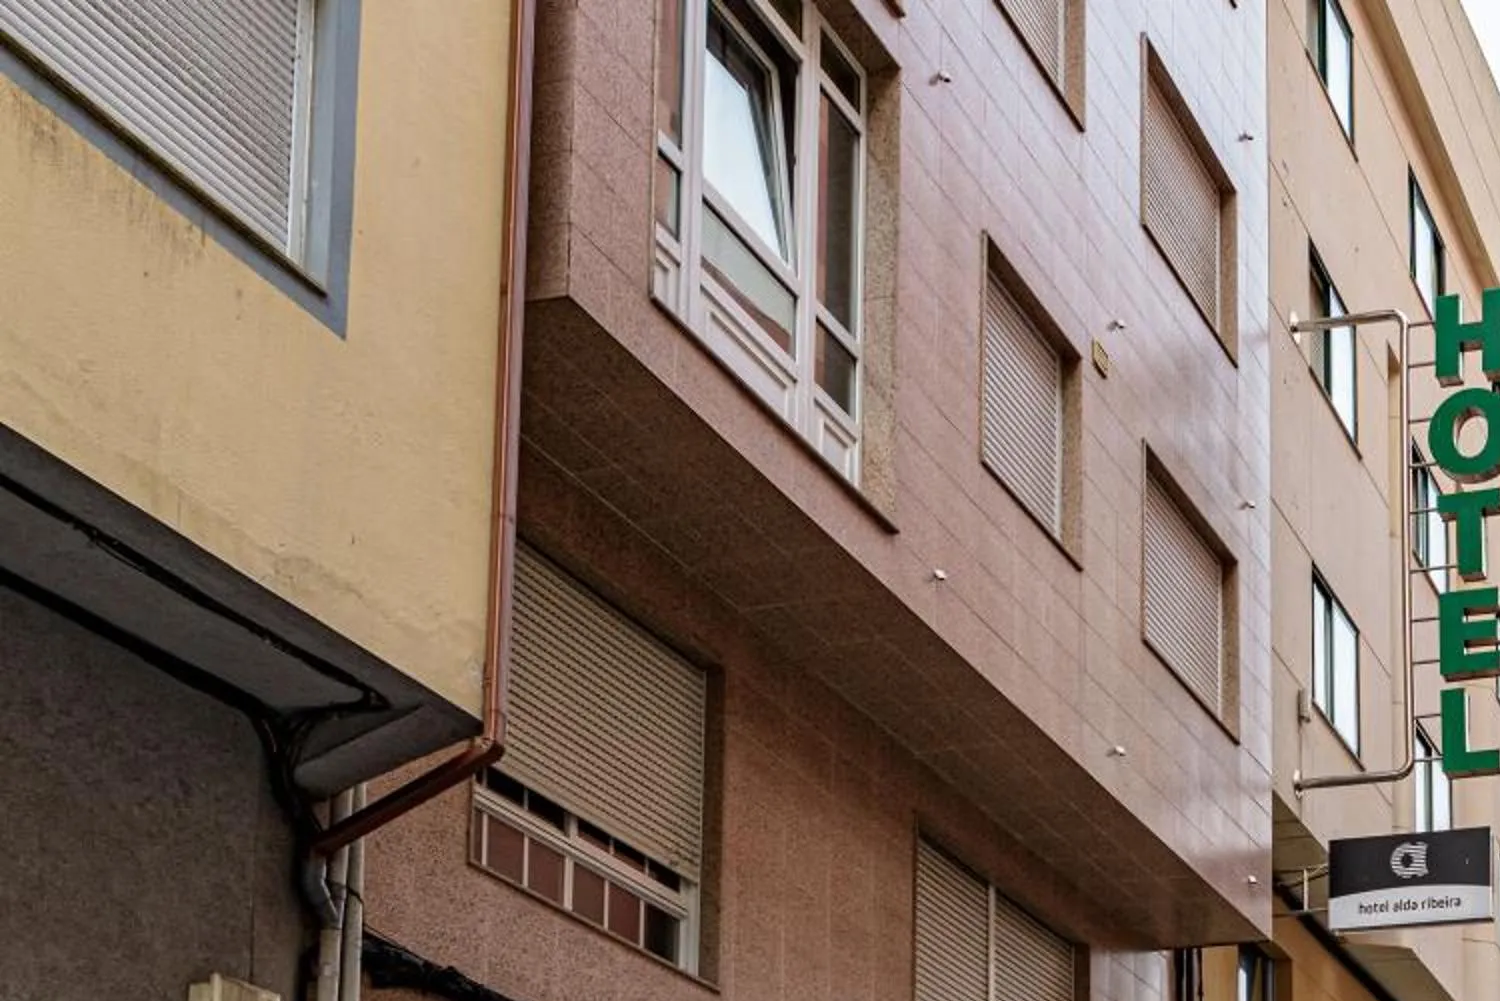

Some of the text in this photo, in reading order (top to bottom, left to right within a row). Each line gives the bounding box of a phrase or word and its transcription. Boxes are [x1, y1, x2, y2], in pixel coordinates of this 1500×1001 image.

[1358, 896, 1462, 915] hotel alda ribeira
